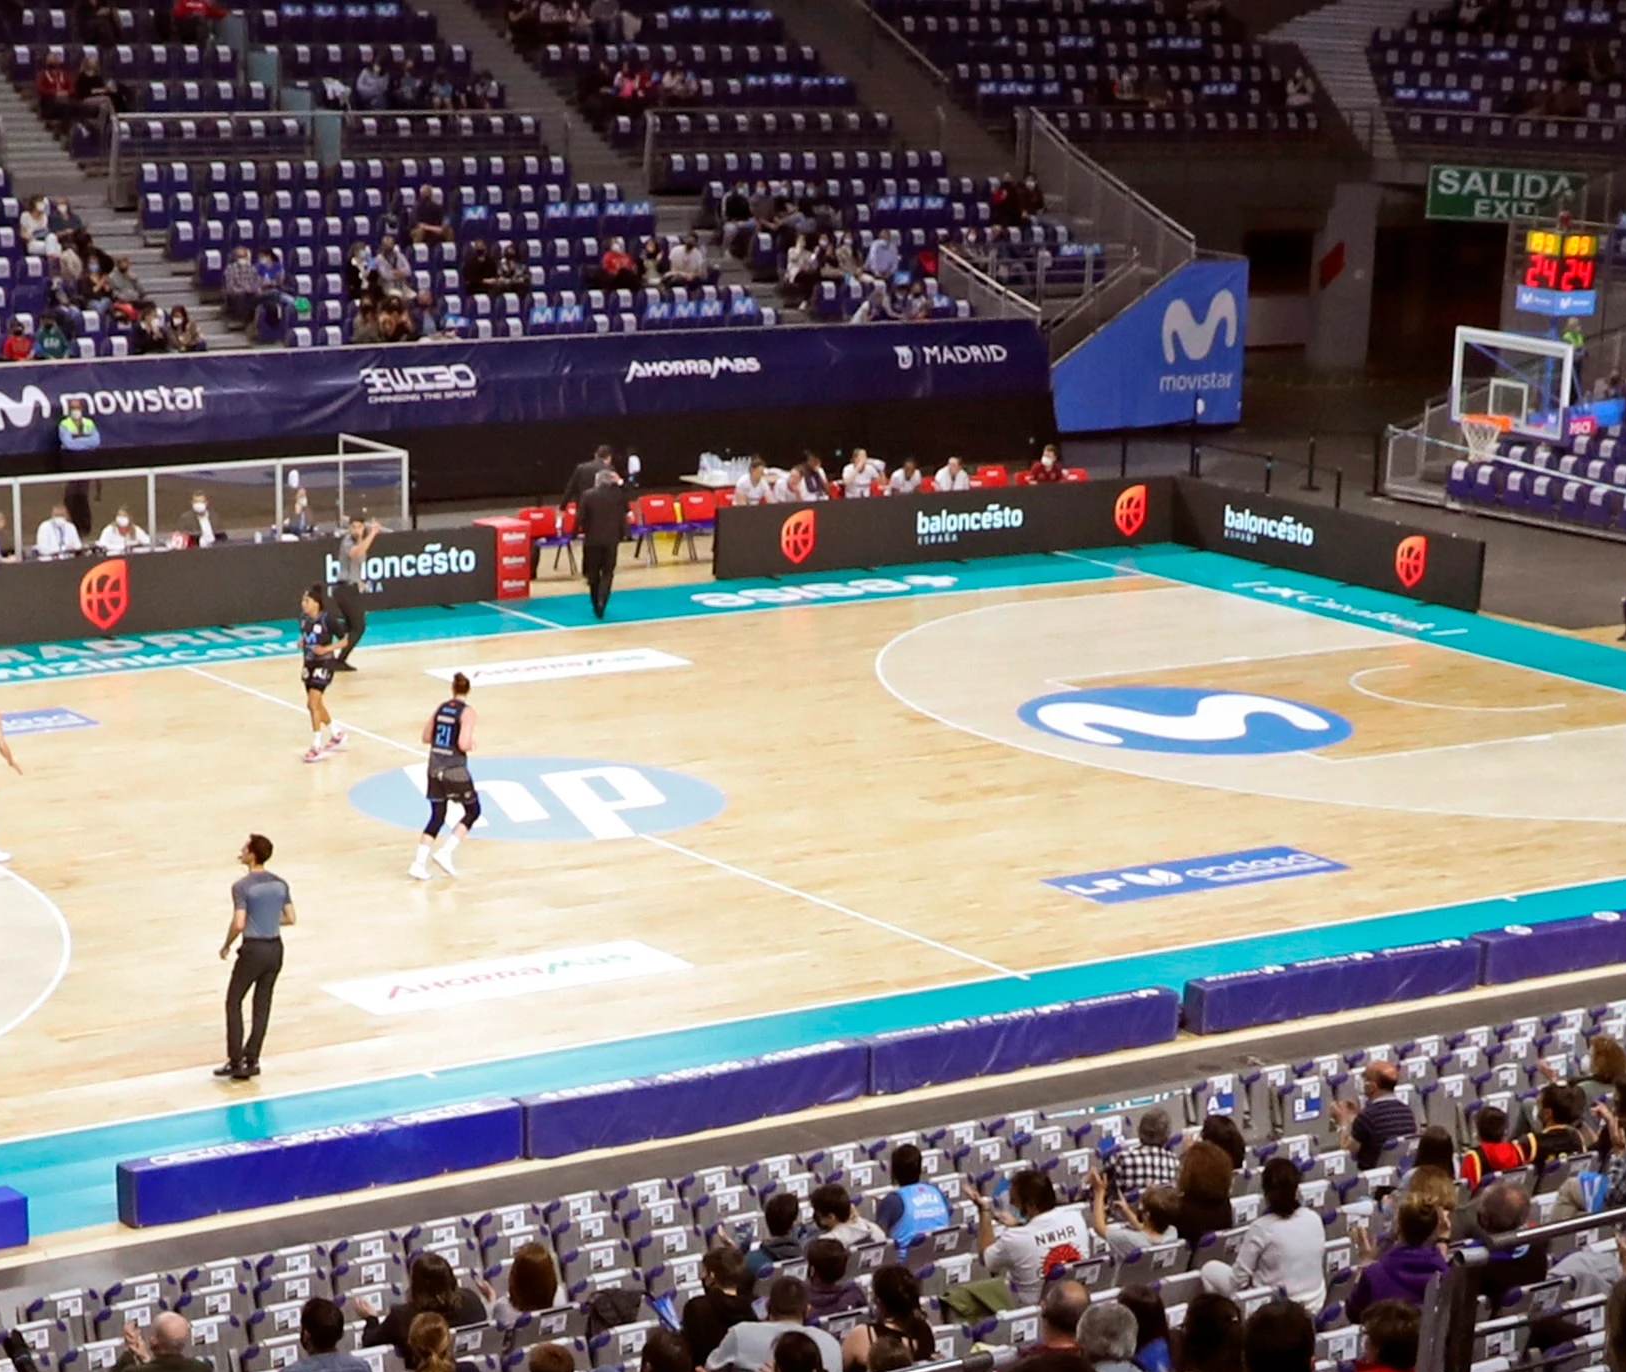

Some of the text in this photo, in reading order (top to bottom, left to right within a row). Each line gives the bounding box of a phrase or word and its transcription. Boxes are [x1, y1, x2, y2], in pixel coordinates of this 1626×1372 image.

[1437, 169, 1574, 199] SALIDA
[1475, 199, 1536, 219] EXIT
[1525, 254, 1557, 288] 24
[1560, 258, 1594, 292] 24
[924, 344, 1008, 365] MADRID
[1159, 371, 1234, 393] movistar
[60, 385, 205, 417] movistar
[1207, 1096, 1220, 1111] A
[1294, 1098, 1306, 1113] B
[1034, 1226, 1077, 1247] NWHR
